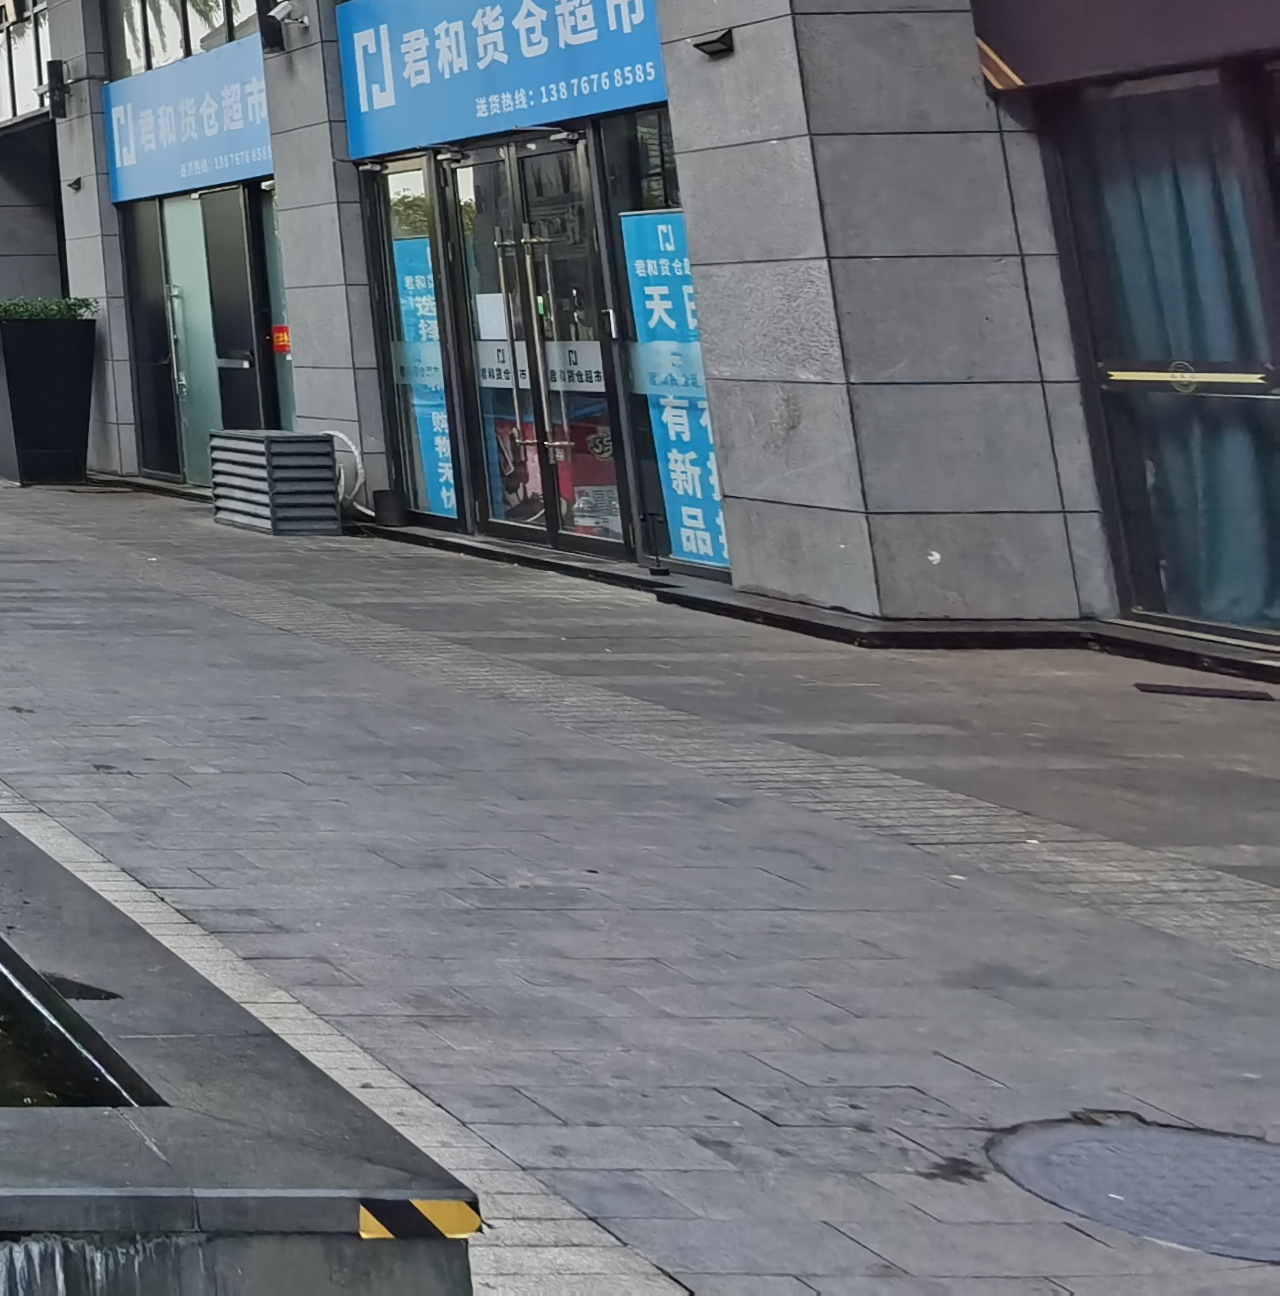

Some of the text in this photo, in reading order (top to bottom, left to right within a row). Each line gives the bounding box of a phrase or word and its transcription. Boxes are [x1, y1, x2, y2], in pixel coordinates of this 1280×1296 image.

[138, 76, 269, 152] 君和货仓超市
